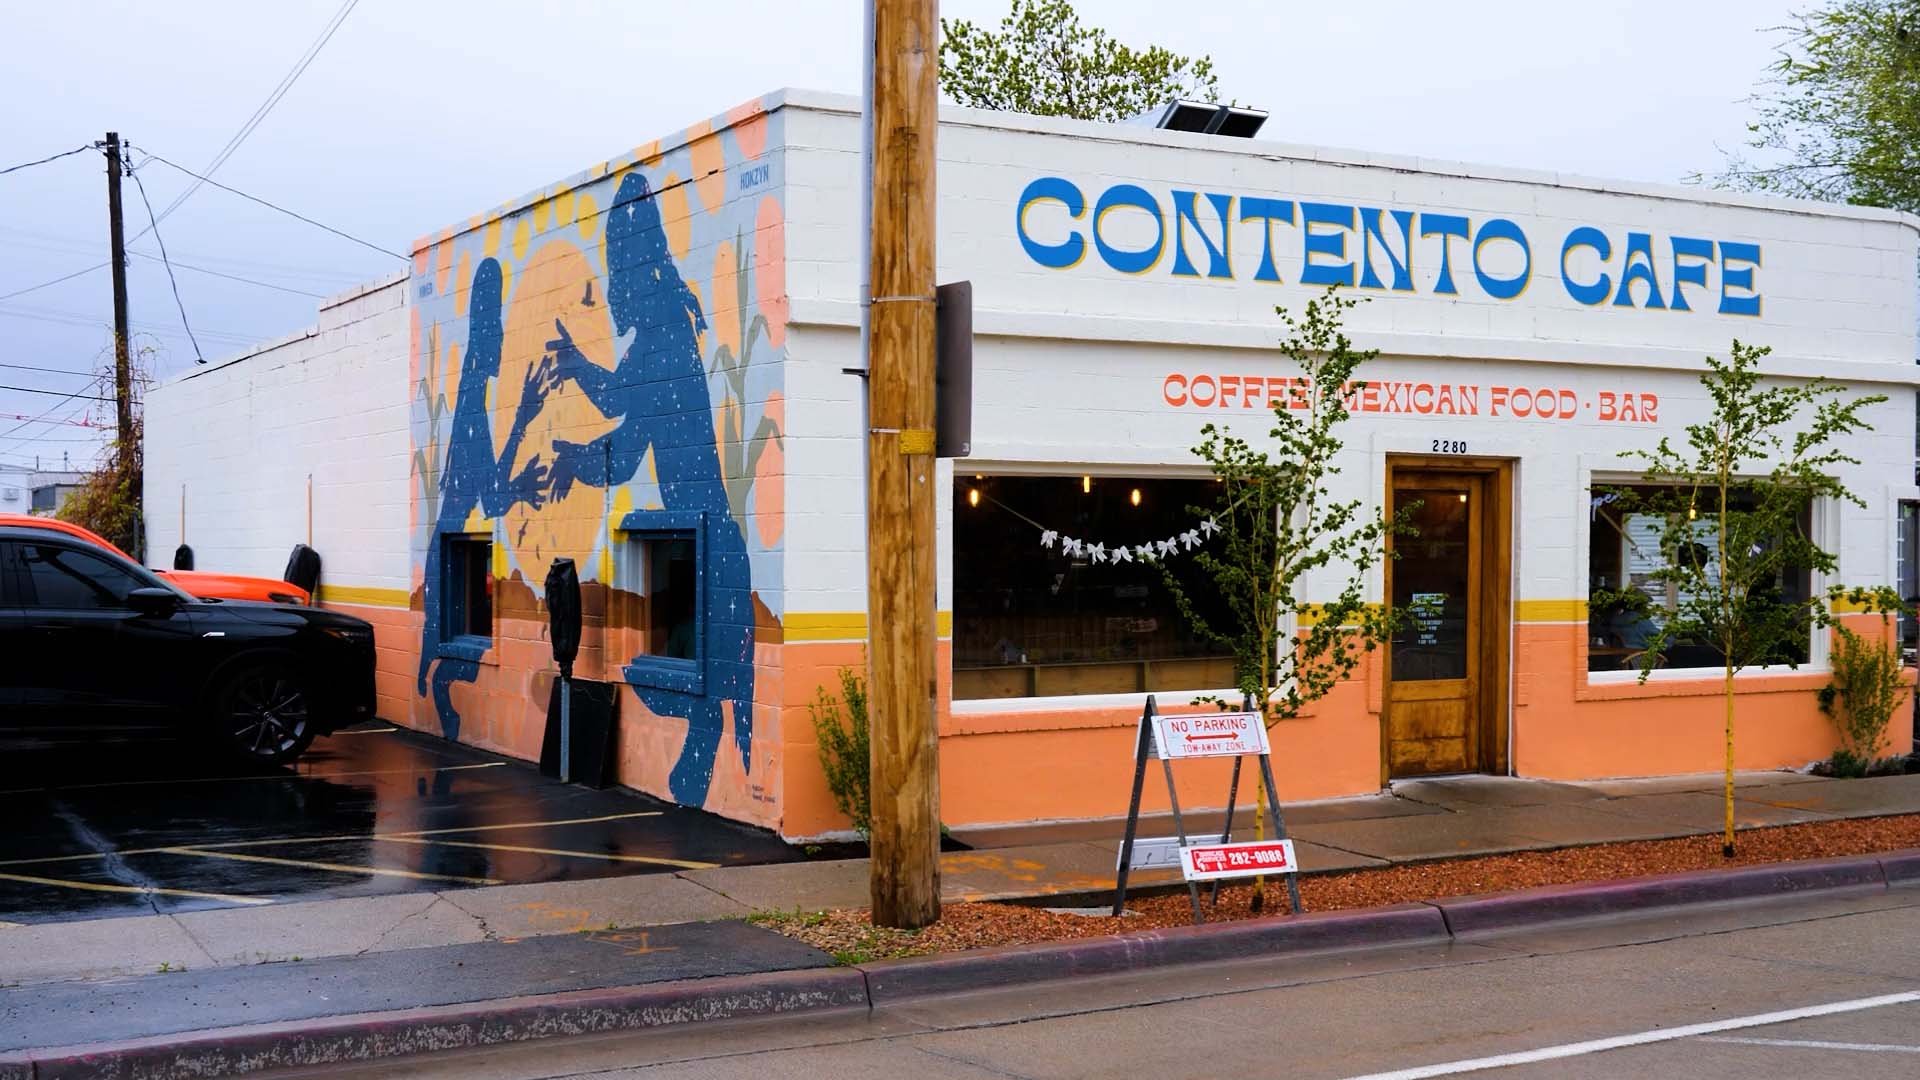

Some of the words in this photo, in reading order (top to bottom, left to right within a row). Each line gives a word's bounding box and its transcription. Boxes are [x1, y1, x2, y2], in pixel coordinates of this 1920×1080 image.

[1016, 176, 1533, 300] CONTENTO
[1559, 226, 1762, 318] CAFE
[1163, 373, 1310, 410] COFFEE
[1490, 386, 1577, 419] FOOD
[1599, 391, 1659, 424] BAR
[1432, 439, 1467, 454] 2280
[1171, 720, 1189, 733] NO
[1194, 718, 1248, 731] PARKING
[1182, 743, 1221, 753] TOW-AWAY
[1225, 741, 1247, 751] ZONE
